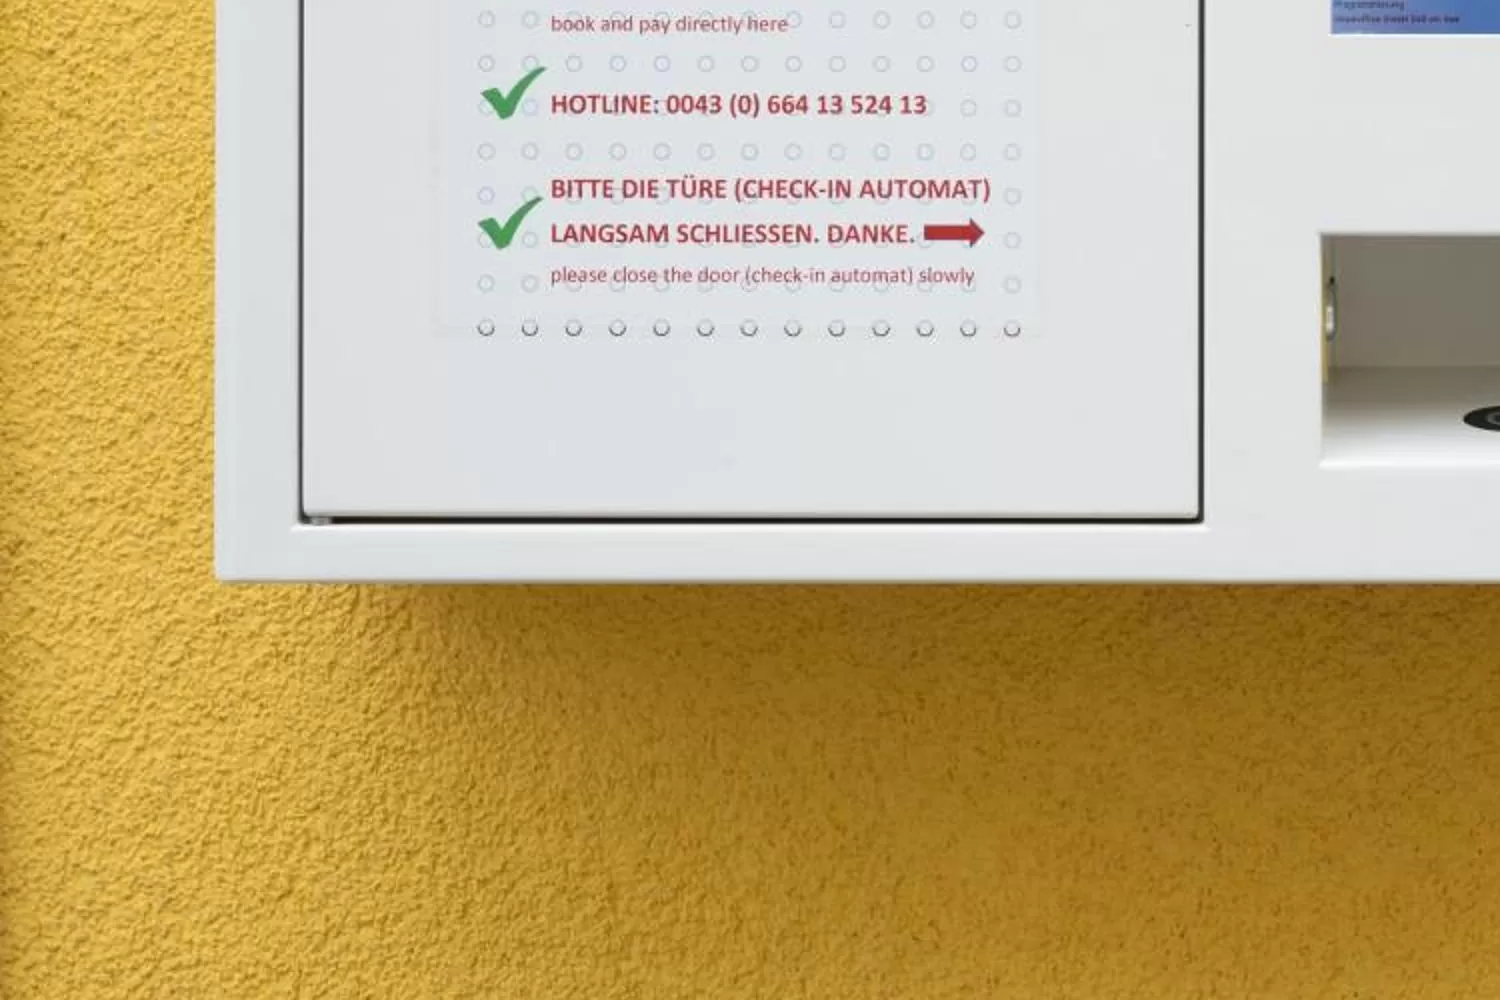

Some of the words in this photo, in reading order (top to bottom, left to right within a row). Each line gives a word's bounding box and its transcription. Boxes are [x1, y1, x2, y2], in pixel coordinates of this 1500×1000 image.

[551, 15, 595, 32] book
[601, 15, 633, 32] and
[639, 19, 670, 36] pay
[675, 15, 742, 36] directly
[747, 15, 789, 32] here
[551, 95, 659, 115] HOTLINE:
[667, 95, 722, 115] 0043
[730, 93, 759, 119] (0)
[768, 95, 808, 115] 664
[817, 95, 843, 115] 13
[851, 95, 891, 115] 524
[900, 95, 927, 115] 13
[551, 179, 612, 199] BITTE
[622, 179, 658, 199] DIE
[666, 173, 726, 199] TÜRE
[734, 177, 851, 203] (CHECK-IN
[859, 177, 991, 203] AUTOMAT)
[551, 223, 669, 244] LANGSAM
[676, 223, 818, 244] SCHLIESSEN.
[827, 224, 915, 244] DANKE.
[551, 266, 606, 286] please
[613, 266, 656, 283] close
[663, 267, 692, 283] the
[698, 266, 739, 283] door
[745, 266, 825, 287] (check-in
[831, 266, 912, 287] automat)
[919, 266, 975, 286] slowly
